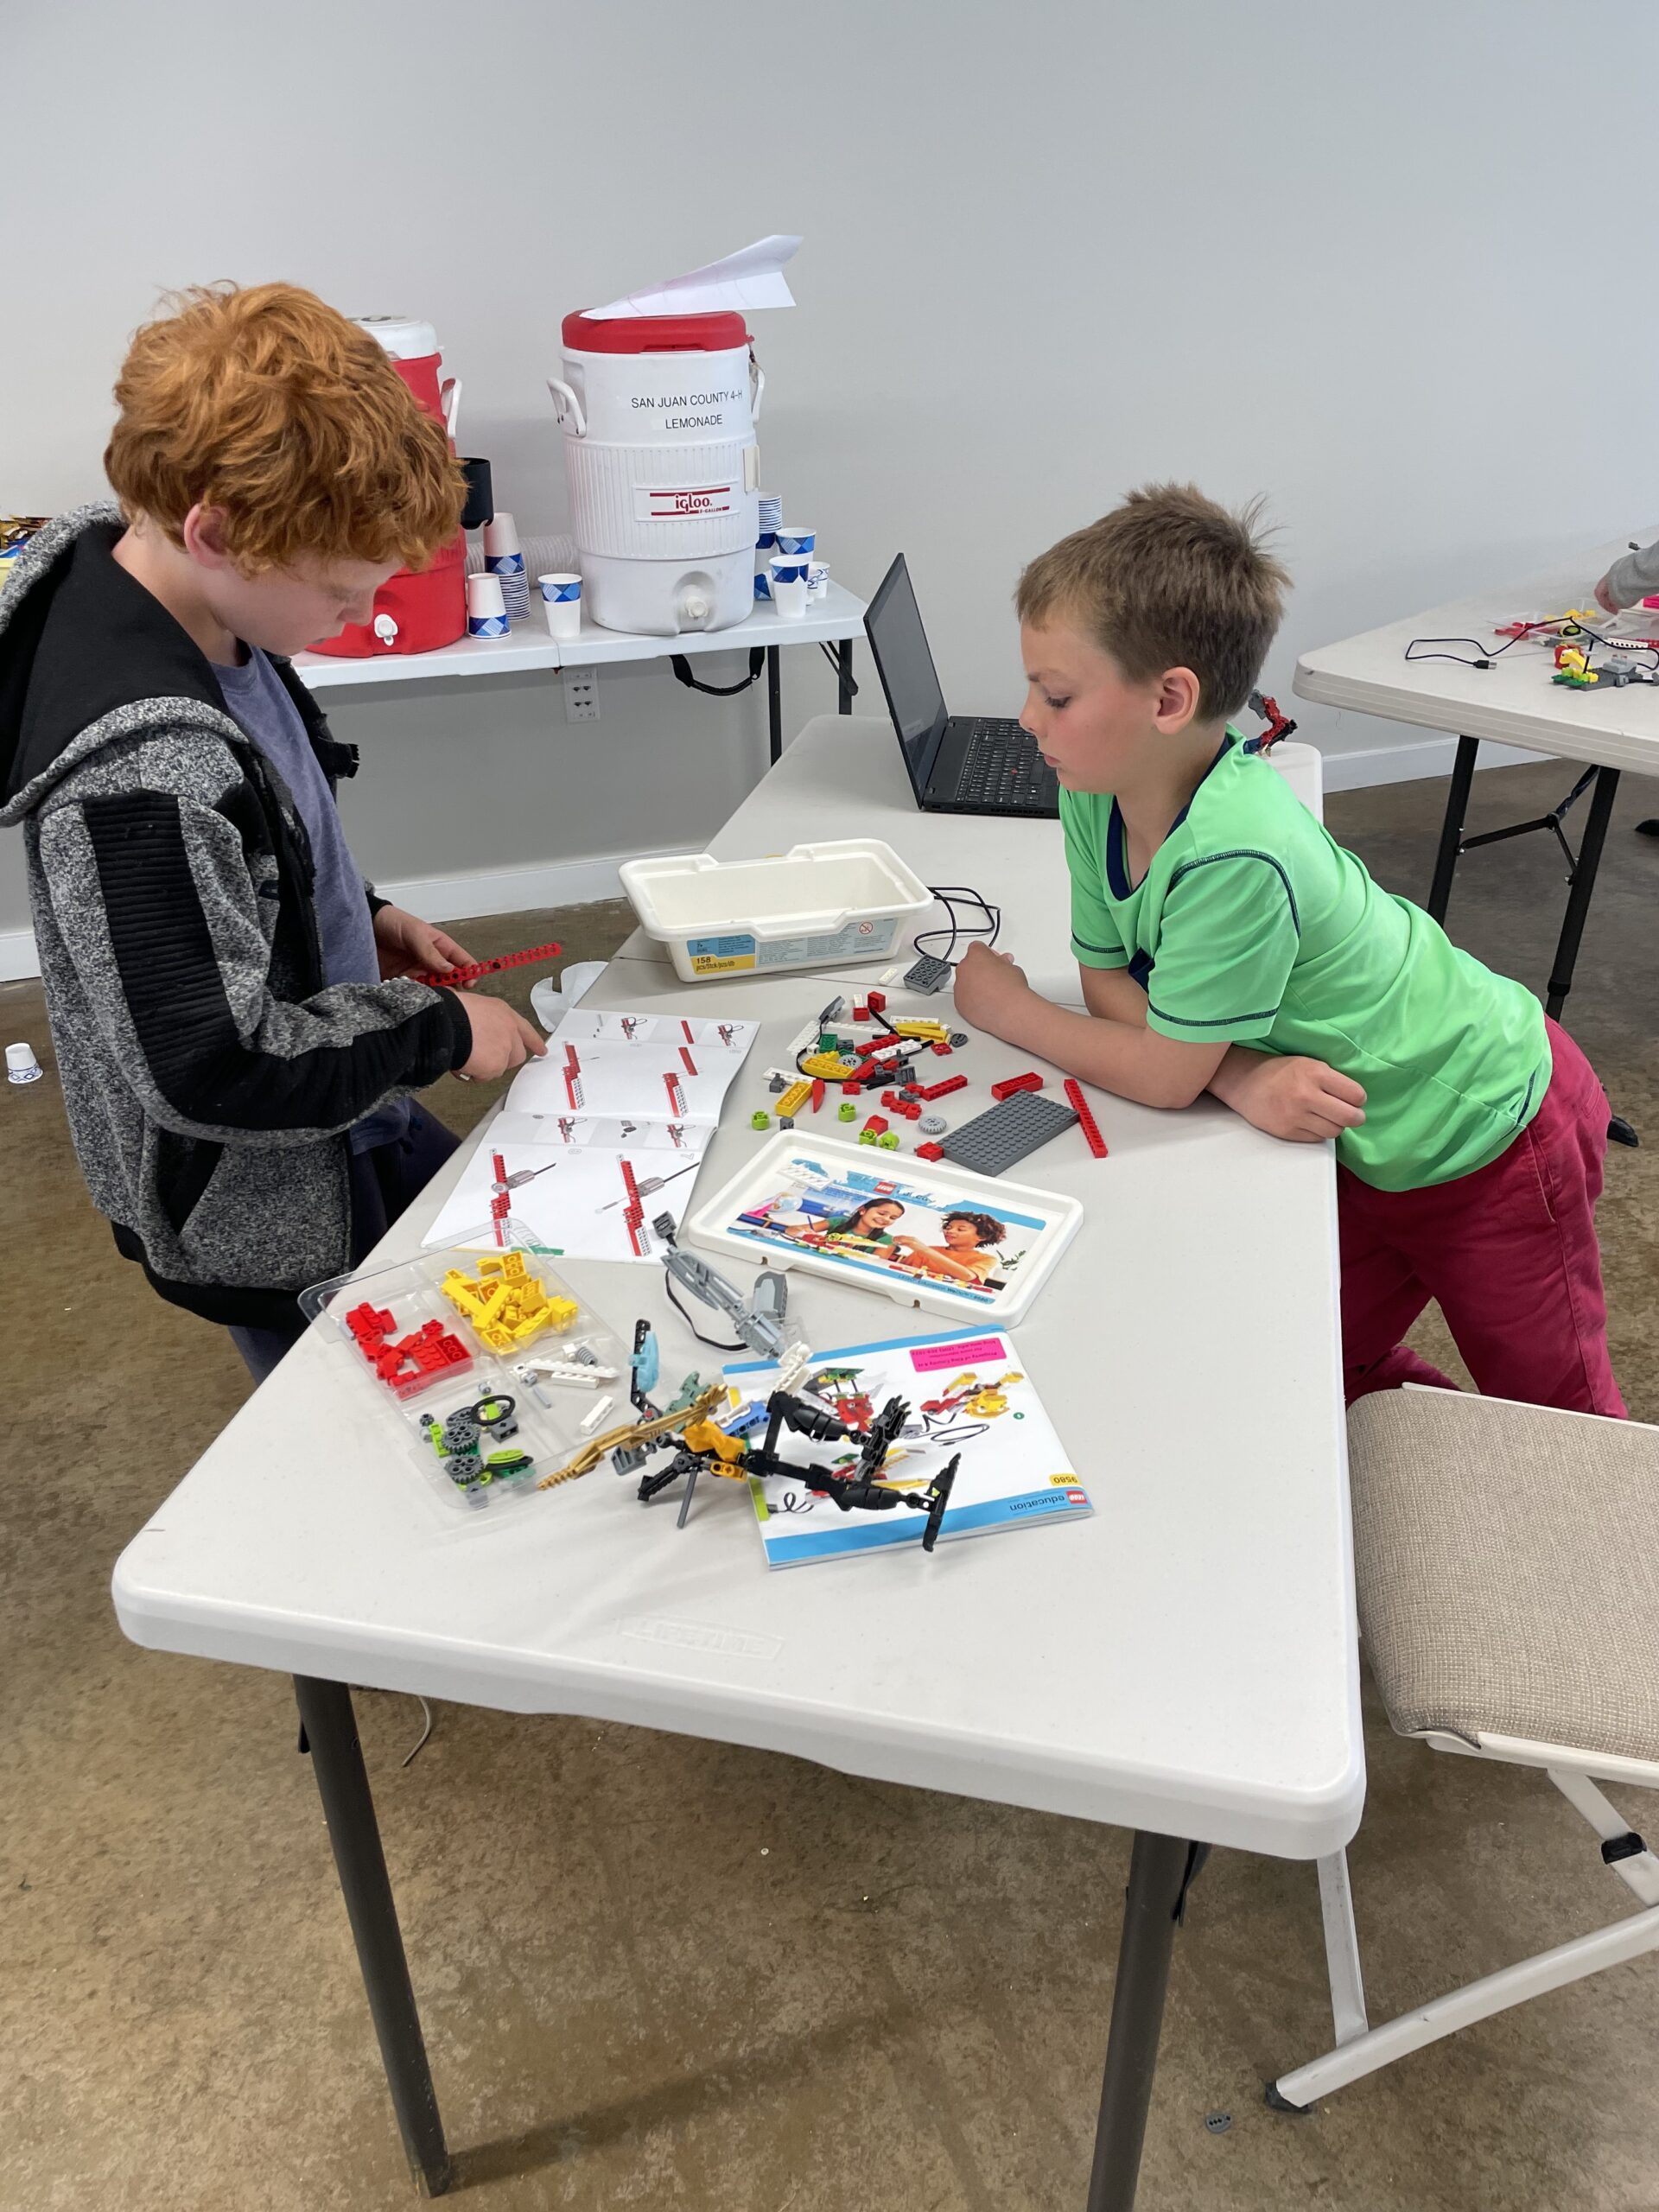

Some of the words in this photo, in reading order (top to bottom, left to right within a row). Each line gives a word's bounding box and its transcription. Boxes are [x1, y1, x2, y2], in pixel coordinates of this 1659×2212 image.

[631, 397, 655, 409] SAN
[658, 397, 688, 408] JUAN
[690, 391, 729, 406] COUNTY
[730, 390, 743, 400] 4-H
[664, 414, 723, 429] LEMONADE
[1009, 1495, 1065, 1511] education
[1069, 1493, 1085, 1502] LEGO
